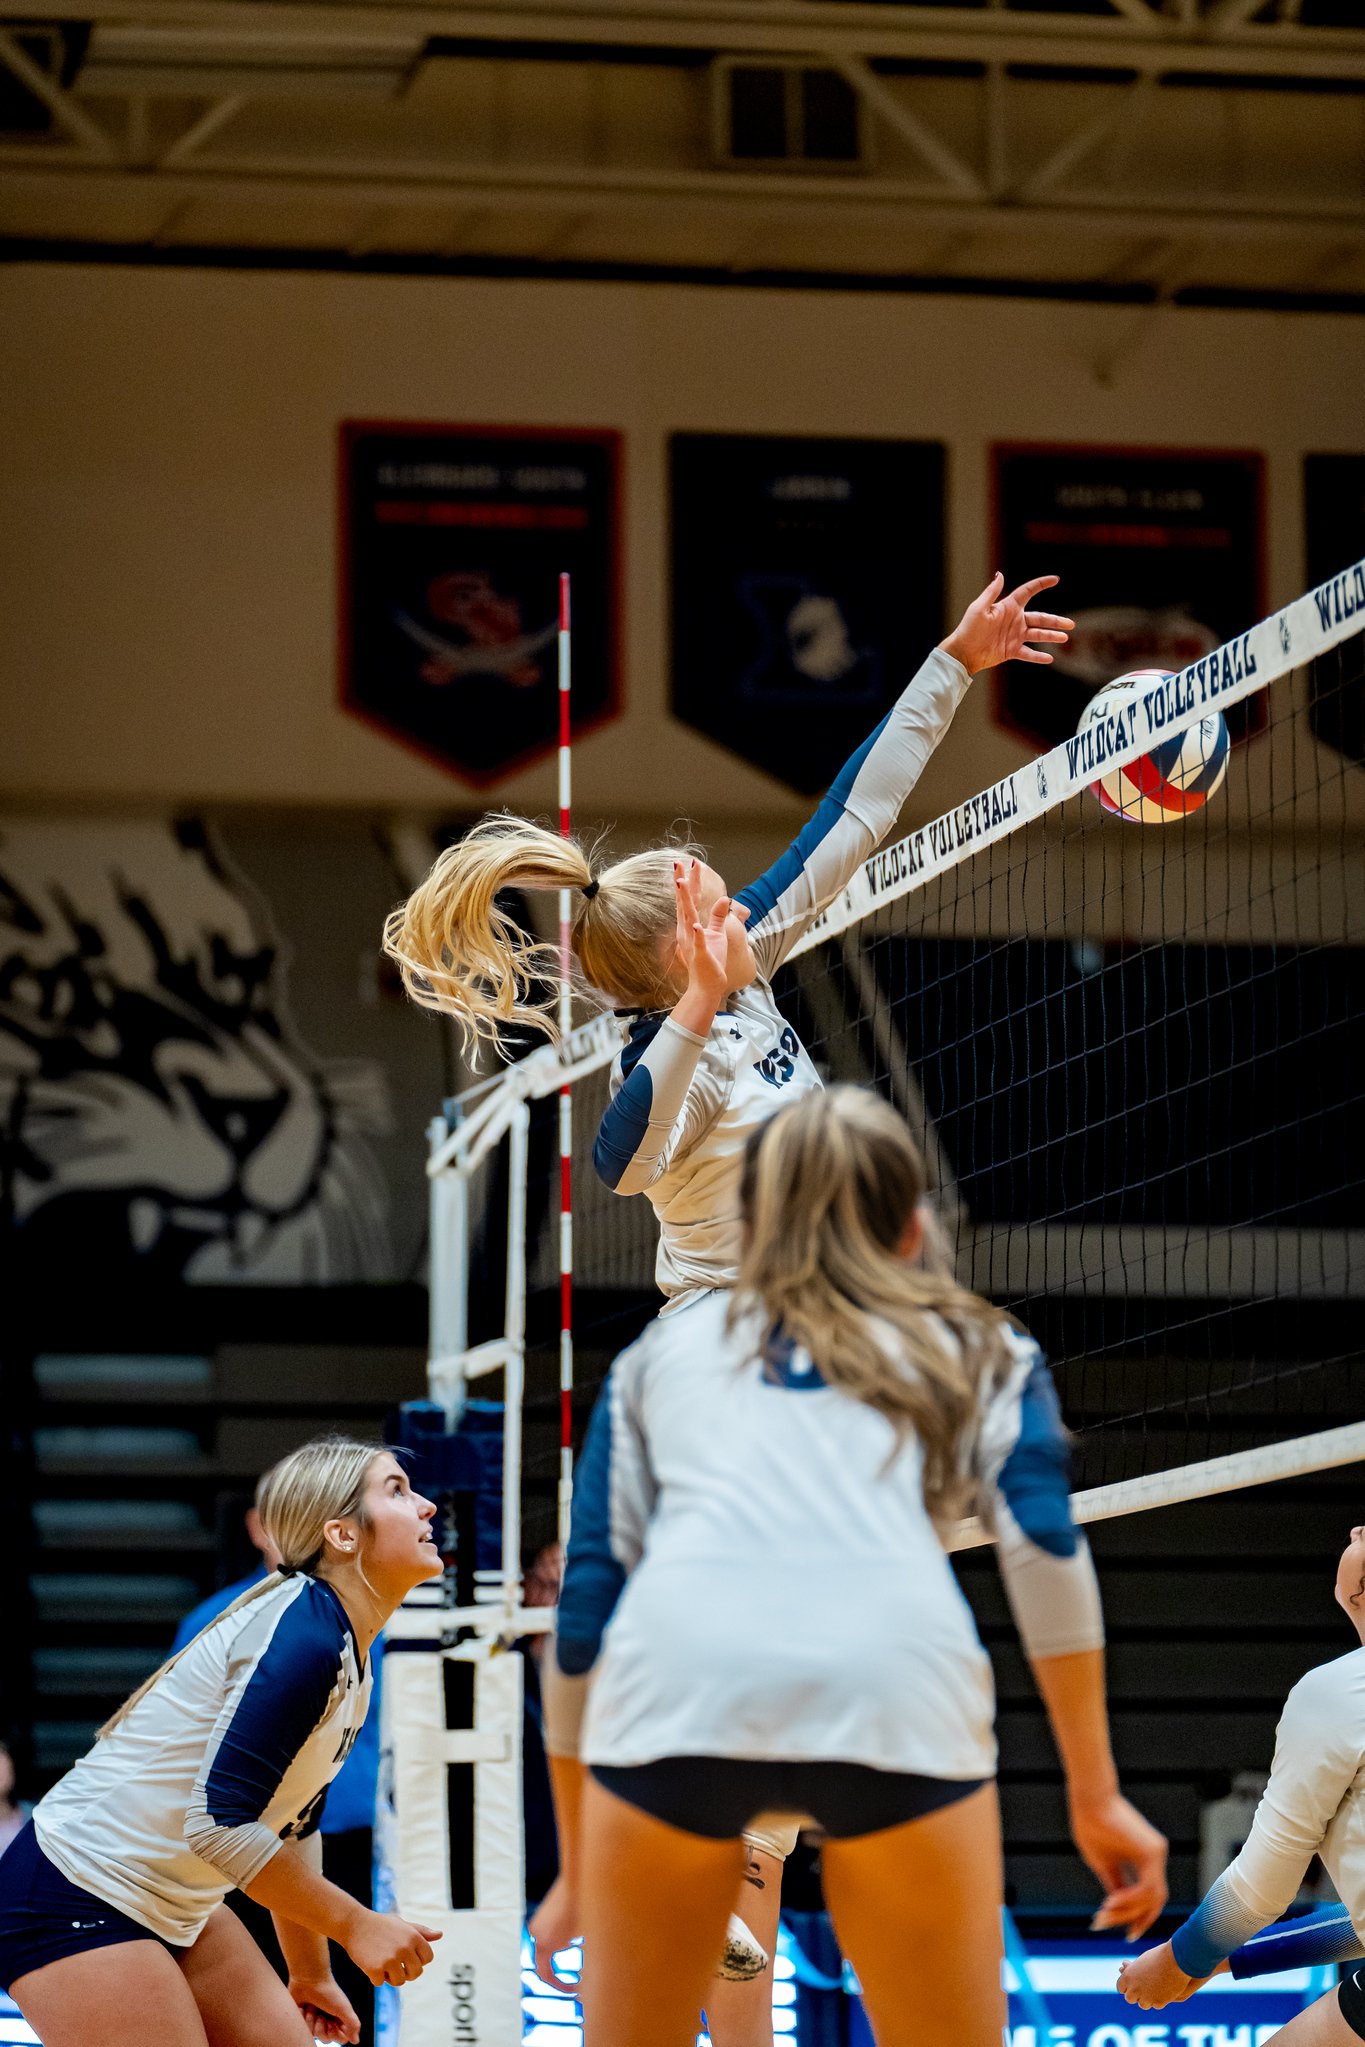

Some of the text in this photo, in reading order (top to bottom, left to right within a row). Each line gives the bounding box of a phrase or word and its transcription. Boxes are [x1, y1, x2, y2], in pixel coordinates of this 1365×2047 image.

[1065, 701, 1137, 781] WILDCAT
[1143, 634, 1257, 735] VOLLEYBALL
[865, 776, 1018, 896] WILDCAT VOLLEYBALL
[447, 1963, 480, 2047] sport
